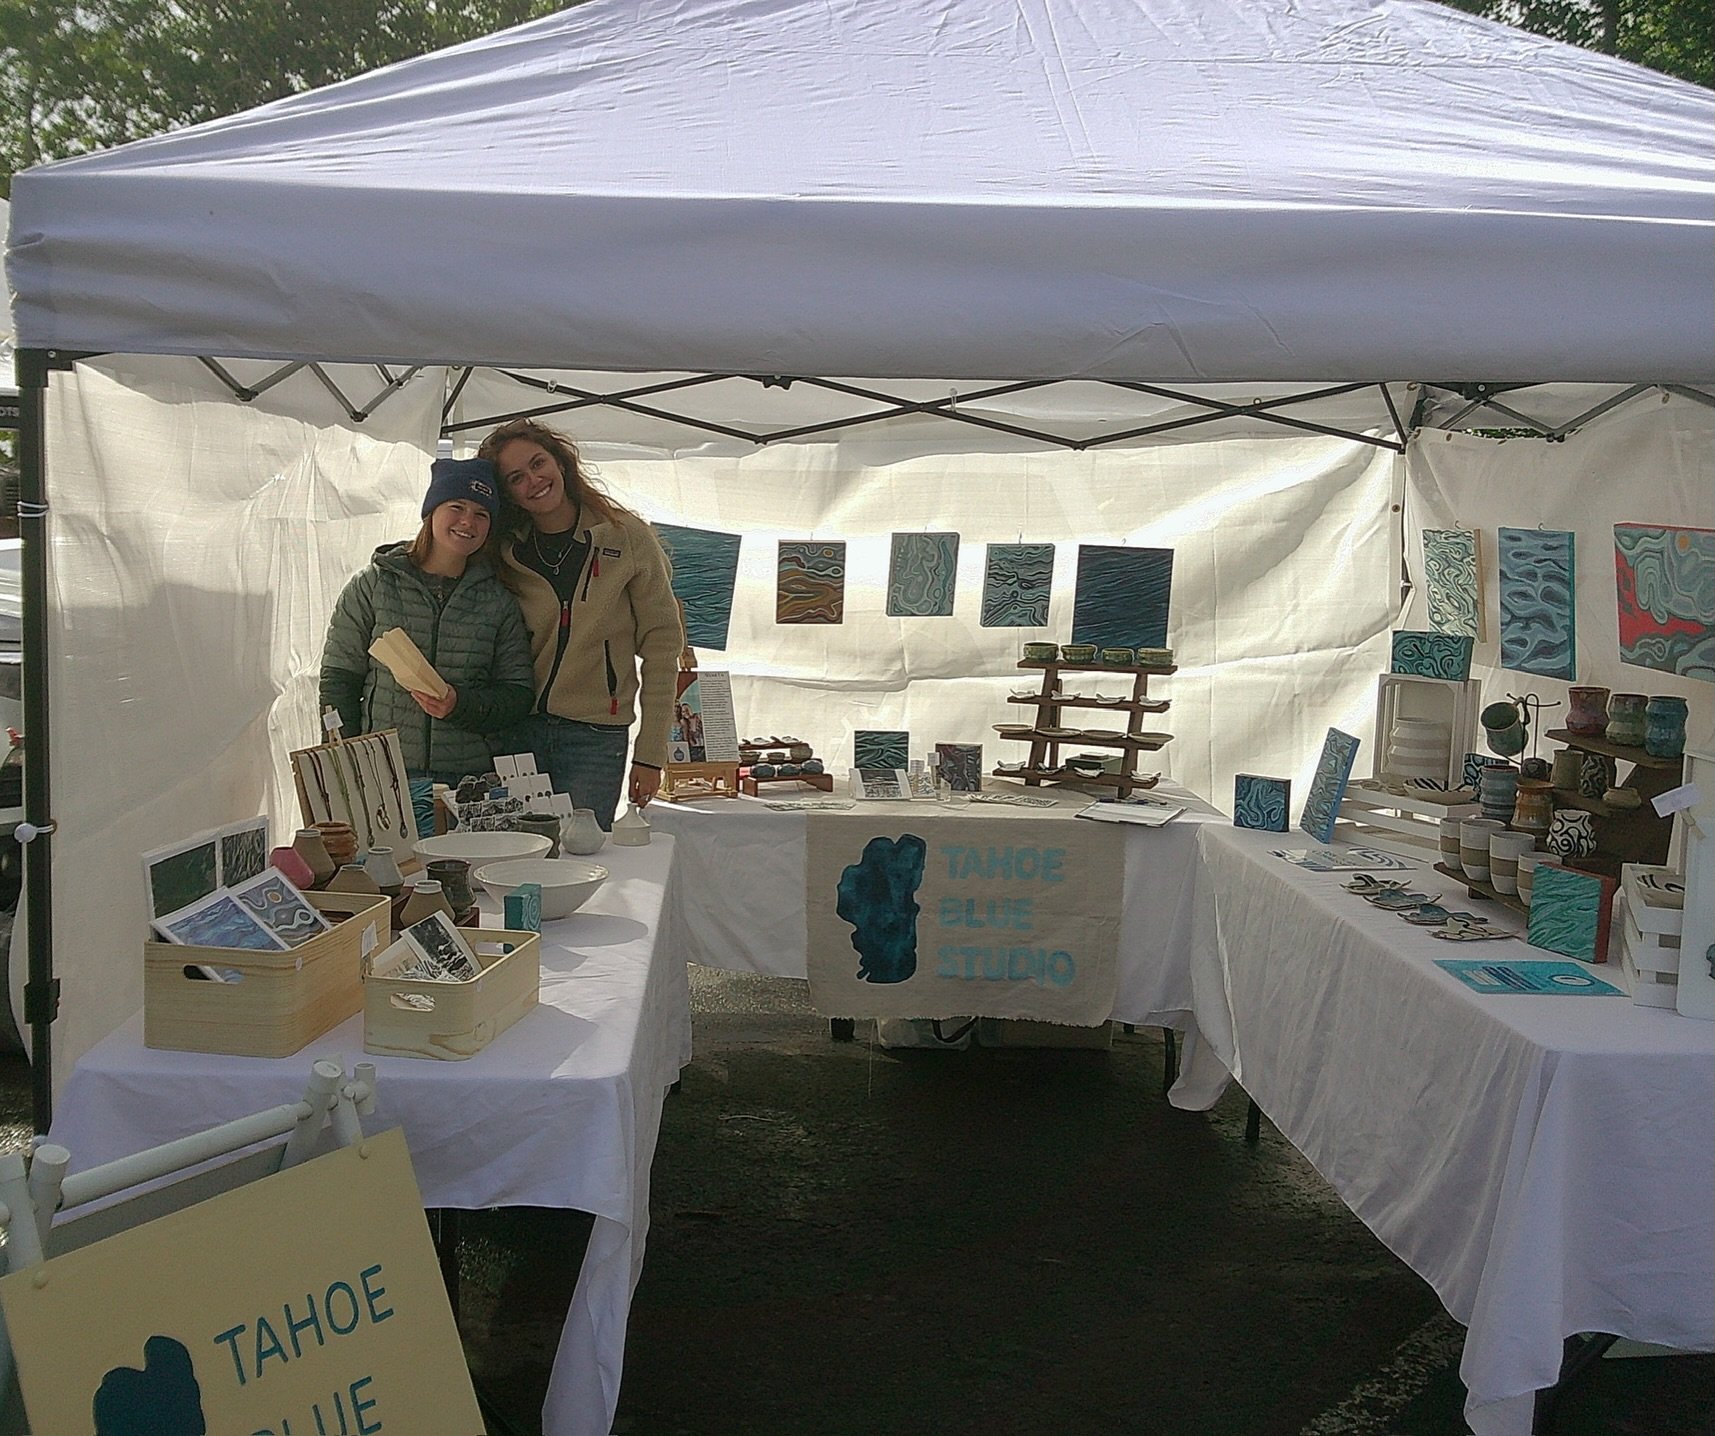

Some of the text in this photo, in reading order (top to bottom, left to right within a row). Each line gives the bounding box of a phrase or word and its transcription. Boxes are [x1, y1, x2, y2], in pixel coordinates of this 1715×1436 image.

[941, 846, 1067, 882] TAHOE
[938, 897, 1034, 930] BLUE
[937, 945, 1075, 987] STUDIO
[214, 1264, 394, 1385] TAHOE
[252, 1376, 382, 1436] UE
